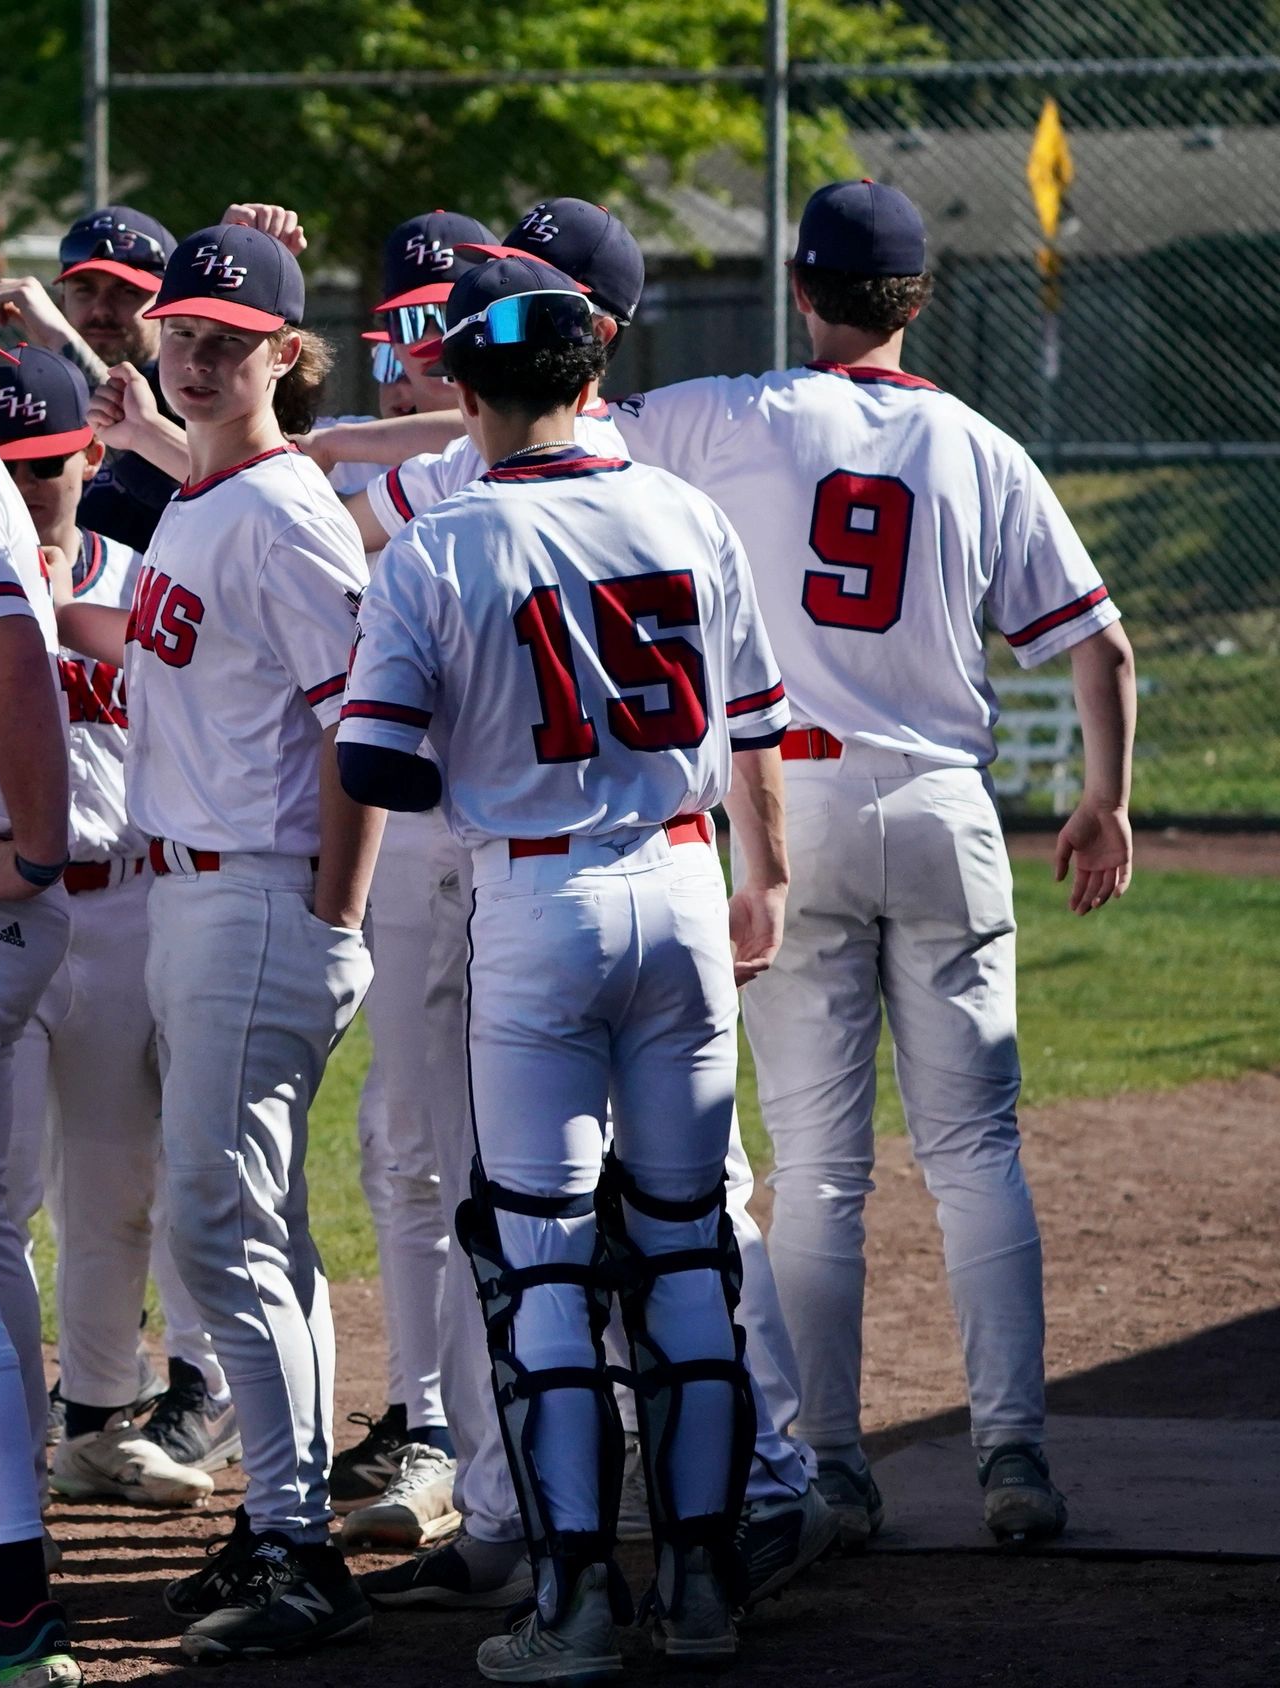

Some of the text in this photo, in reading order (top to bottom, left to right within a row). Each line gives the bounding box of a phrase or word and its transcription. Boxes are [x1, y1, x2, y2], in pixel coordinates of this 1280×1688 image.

[191, 244, 247, 289] SHS
[405, 235, 454, 272] SHS
[801, 468, 915, 635] 9
[513, 569, 710, 765] 15
